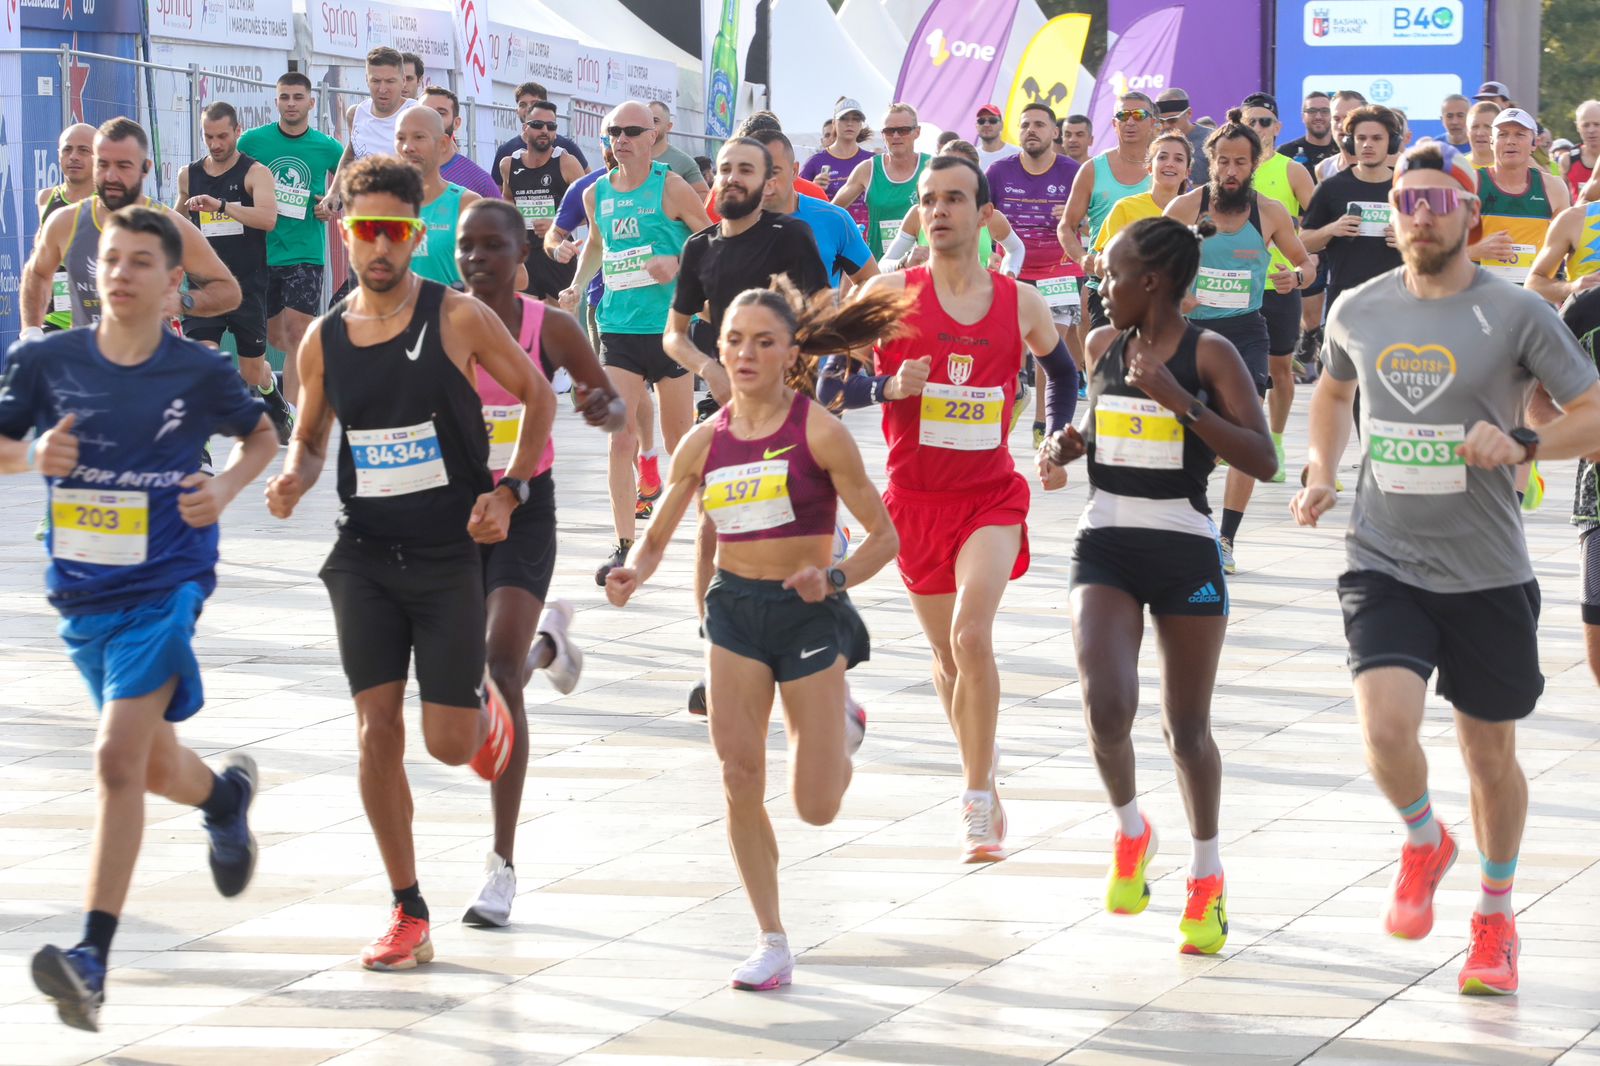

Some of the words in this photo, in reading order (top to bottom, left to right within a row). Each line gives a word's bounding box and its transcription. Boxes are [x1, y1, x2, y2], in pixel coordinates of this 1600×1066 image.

[322, 2, 358, 48] Spring
[951, 40, 996, 62] one
[577, 54, 600, 94] pring
[1128, 74, 1164, 89] one
[275, 191, 304, 205] 3080
[522, 207, 548, 216] 2120
[612, 257, 644, 272] 2244
[1045, 283, 1073, 294] 3015
[1206, 278, 1242, 291] 2104
[1406, 385, 1424, 399] 10
[944, 401, 985, 420] 228
[1129, 416, 1142, 435] 3
[365, 442, 426, 465] 8434
[1381, 439, 1451, 463] 2003
[71, 464, 116, 484] FOR
[724, 478, 761, 502] 197
[75, 506, 119, 530] 203
[1188, 594, 1221, 603] adidas
